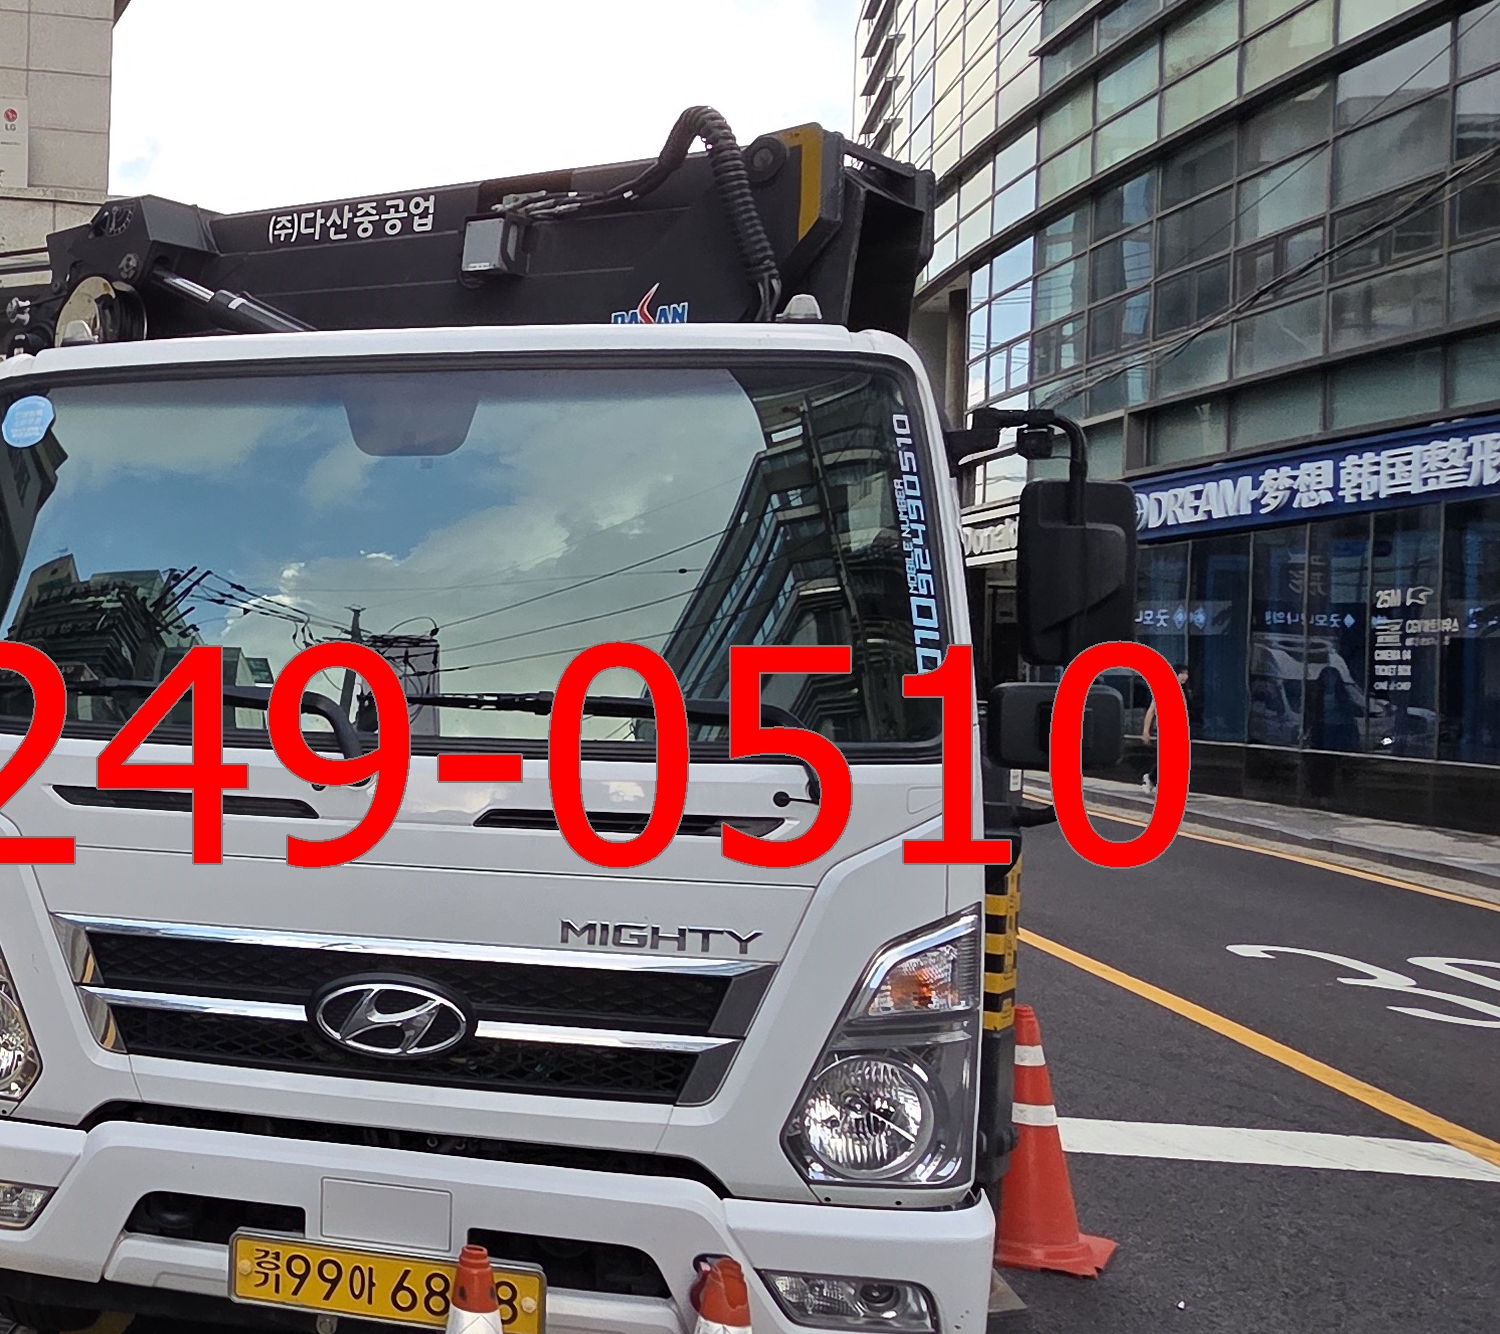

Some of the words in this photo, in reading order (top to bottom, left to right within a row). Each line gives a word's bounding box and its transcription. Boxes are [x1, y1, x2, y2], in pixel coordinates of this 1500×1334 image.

[4, 123, 17, 132] LG
[268, 195, 436, 244] (주)다산중공업
[893, 478, 914, 539] NUMBER
[1147, 476, 1252, 529] DREAM
[902, 540, 919, 594] MOBILE
[560, 918, 764, 955] MIGHTY
[390, 1269, 519, 1326] 688
